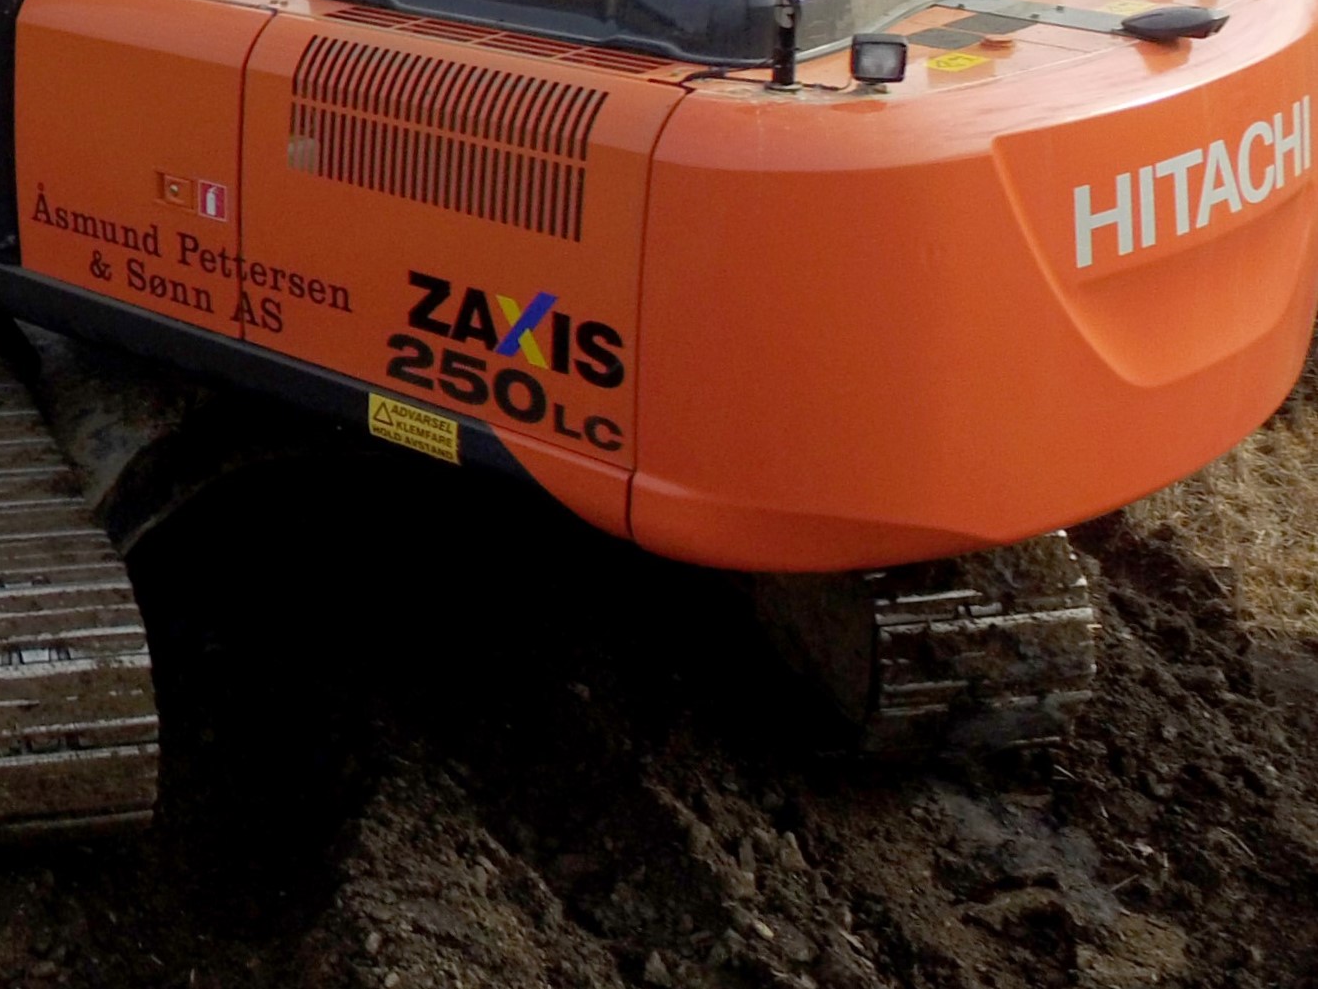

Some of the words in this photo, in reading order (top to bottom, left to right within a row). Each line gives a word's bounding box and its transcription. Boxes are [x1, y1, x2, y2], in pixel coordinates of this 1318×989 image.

[1073, 95, 1311, 269] HITACHI
[32, 182, 162, 258] Åsmund
[176, 231, 353, 313] Pettersen
[89, 249, 112, 282] &
[126, 257, 214, 314] Sønn
[229, 290, 284, 333] AS
[408, 269, 625, 389] ZAXIS
[390, 404, 453, 434] ADVARSEL
[395, 421, 453, 448] KLEMFARE
[404, 436, 454, 460] AVSTAND
